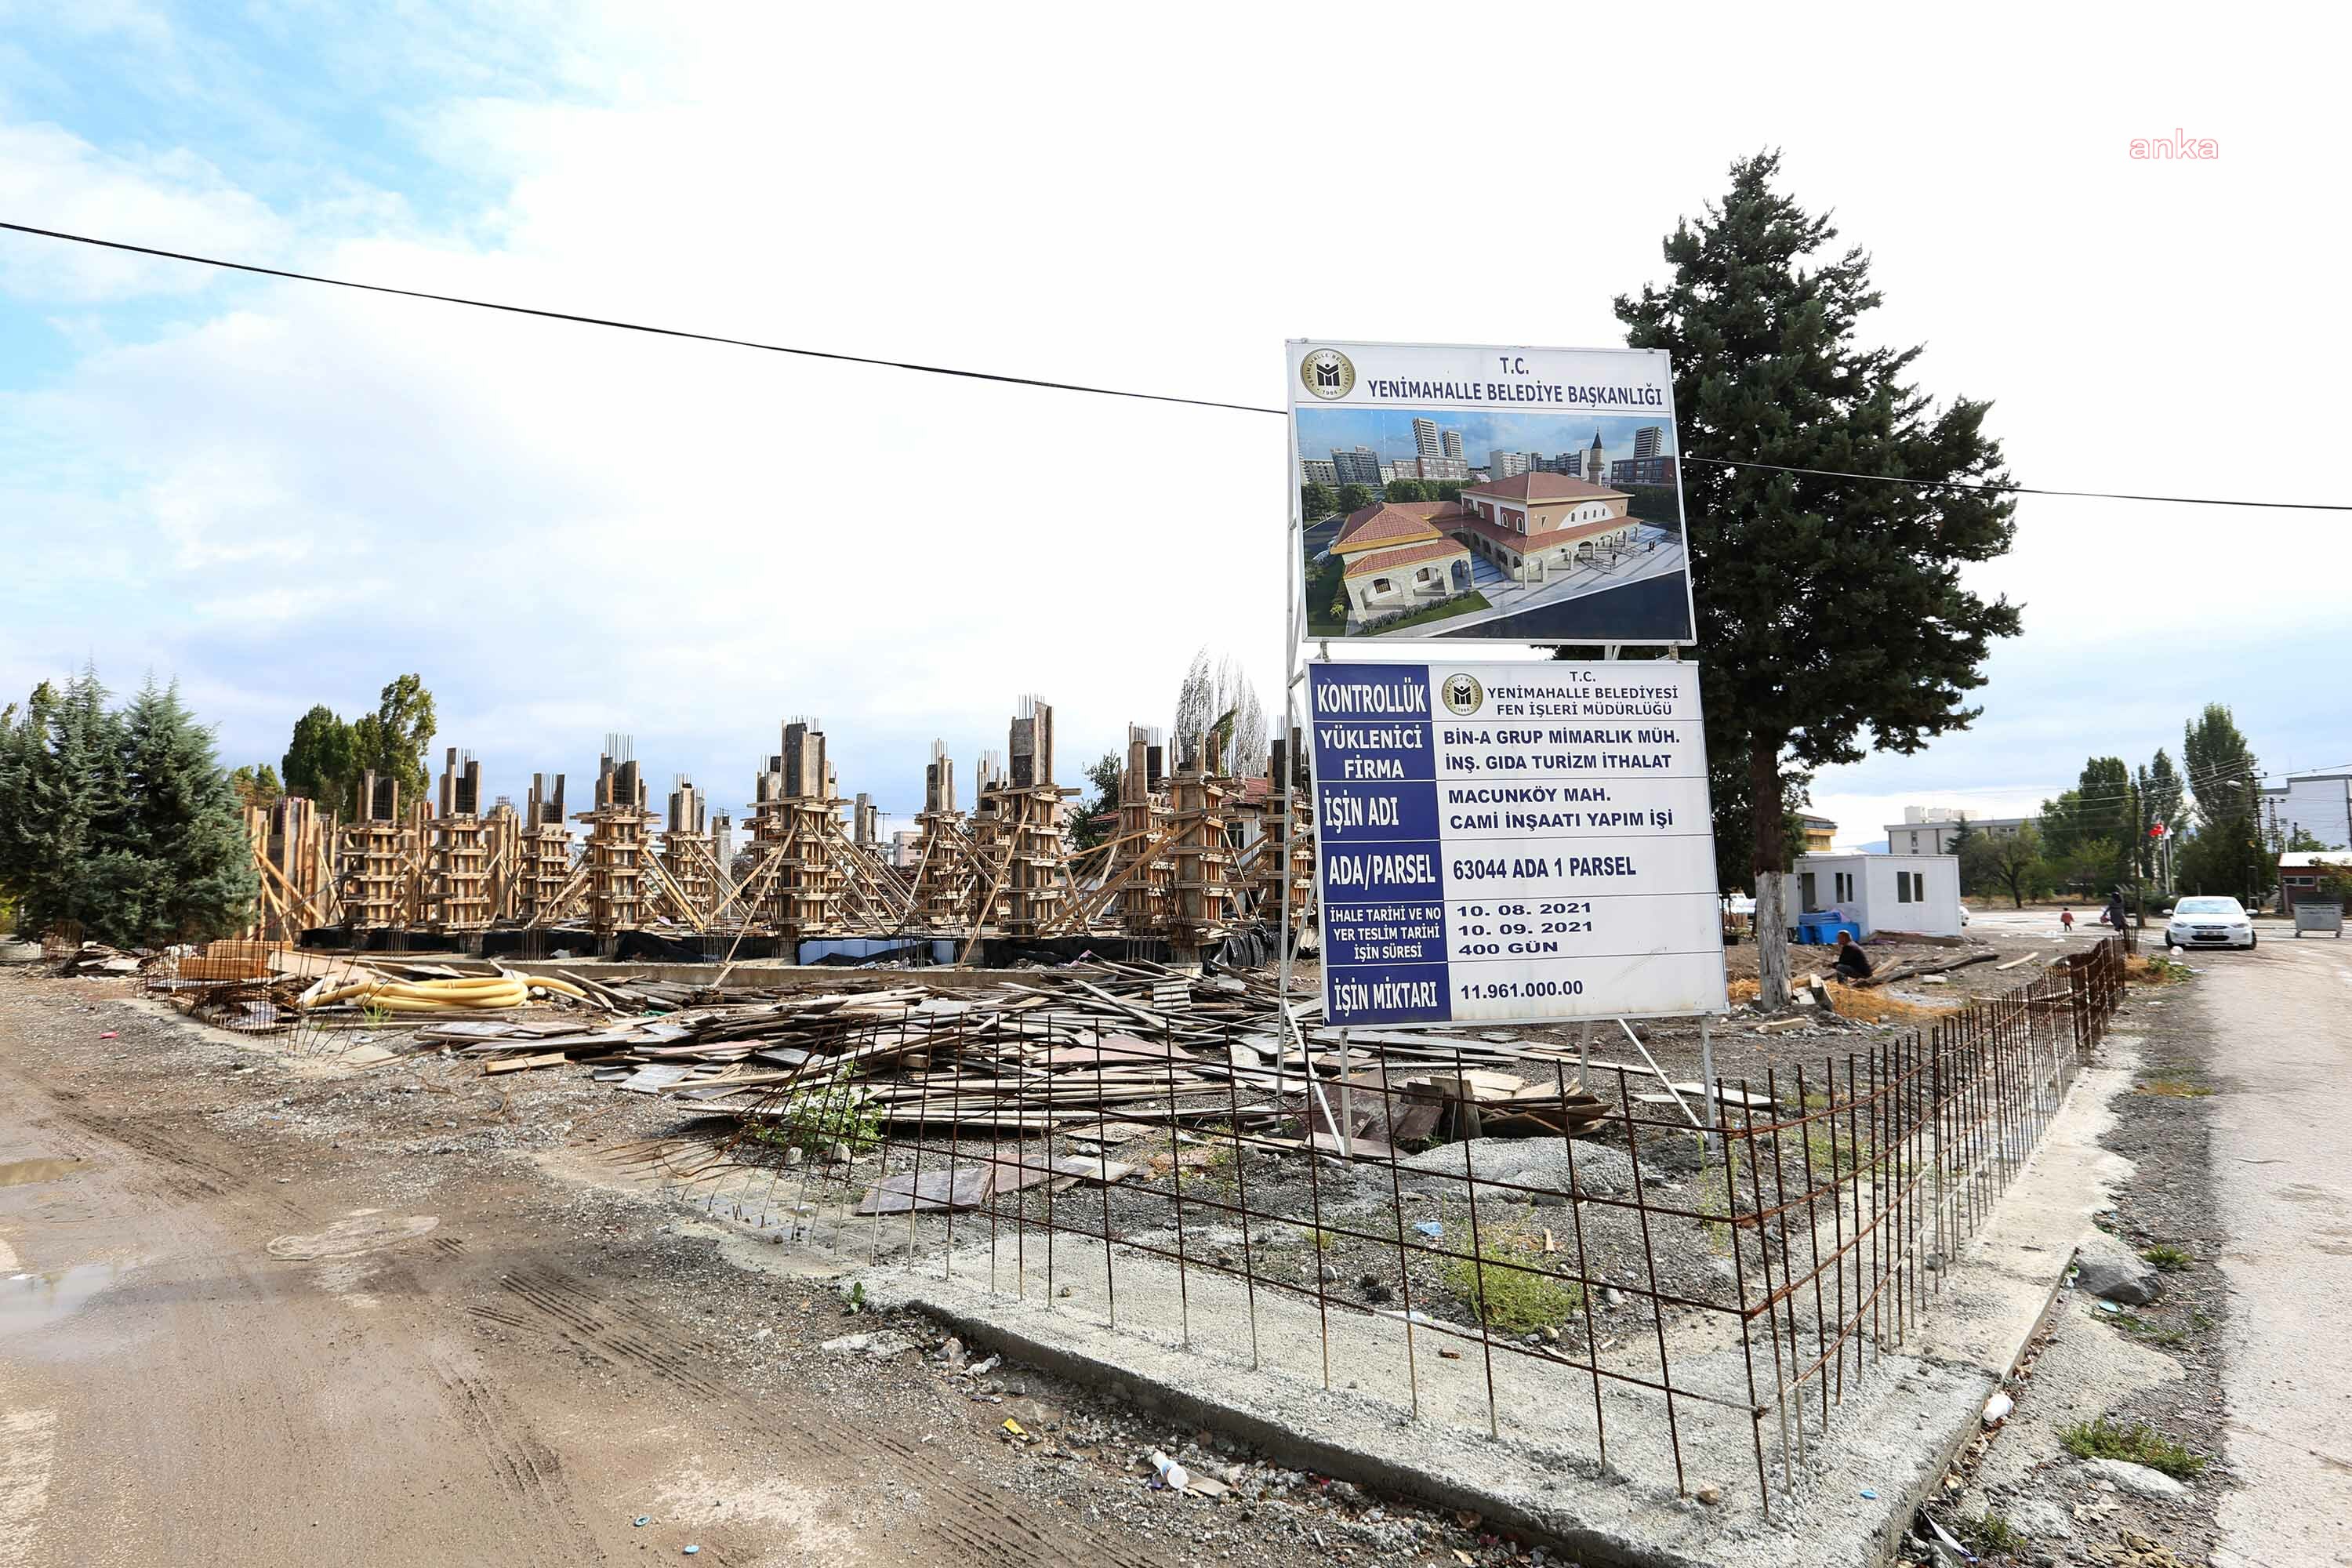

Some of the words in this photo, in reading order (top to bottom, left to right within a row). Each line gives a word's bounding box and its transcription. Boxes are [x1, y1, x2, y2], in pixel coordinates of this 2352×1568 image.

[1500, 358, 1529, 374] T.C.
[1368, 376, 1482, 400] YENİMAHALLE
[1487, 380, 1563, 401] BELEDİYE
[1568, 383, 1662, 407] BAŞKANLIĞI
[1570, 672, 1595, 681] T.C.
[1318, 677, 1426, 712] KONTROLLÜK
[1488, 685, 1589, 698] YENİMAHALLE
[1595, 685, 1678, 699] BELEDİYESİ
[1497, 705, 1523, 715] FEN
[1530, 702, 1577, 717] İŞLERİ
[1584, 701, 1671, 715] MÜDÜRLÜĞÜ
[1320, 725, 1422, 749] YÜKLENİCİ
[1444, 728, 1491, 744] BİN-A
[1497, 731, 1543, 744] GRUP
[1549, 728, 1632, 743] MİMARLIK
[1638, 728, 1679, 743] MÜH.
[1345, 755, 1404, 778] FİRMA
[1446, 753, 1479, 773] İNŞ.
[1486, 756, 1526, 769] GIDA
[1532, 752, 1596, 768] TURİZM
[1602, 752, 1671, 768] İTHALAT
[1449, 786, 1557, 803] MACUNKÖY
[1564, 788, 1610, 801] MAH.
[1324, 789, 1363, 833] İŞİN
[1369, 797, 1399, 826] ADI
[1450, 811, 1498, 829] CAMİ
[1506, 811, 1580, 831] İNŞAATI
[1587, 813, 1643, 826] YAPIM
[1650, 809, 1672, 829] İŞİ
[1330, 855, 1436, 890] ADA/PARSEL
[1454, 859, 1507, 880] 63044
[1513, 858, 1548, 878] ADA
[1555, 858, 1562, 877] 1
[1570, 857, 1636, 876] PARSEL
[1330, 907, 1363, 922] İHALE
[1367, 906, 1405, 921] TARİHİ
[1409, 908, 1422, 920] VE
[1426, 907, 1441, 920] NO
[1457, 906, 1490, 916] 10.
[1498, 905, 1531, 915] 08.
[1541, 902, 1590, 914] 2021
[1334, 929, 1355, 941] YER
[1358, 924, 1397, 940] TESLİM
[1401, 923, 1439, 938] TARİHİ
[1459, 925, 1491, 935] 10.
[1500, 924, 1533, 935] 09.
[1541, 922, 1592, 933] 2021
[1355, 944, 1379, 962] İŞİN
[1383, 943, 1422, 958] SÜRESİ
[1459, 944, 1499, 955] 400
[1508, 941, 1558, 953] GÜN
[1334, 978, 1368, 1016] İŞİN
[1374, 977, 1437, 1009] MİKTARI
[1461, 981, 1582, 999] 11.961.000.00
